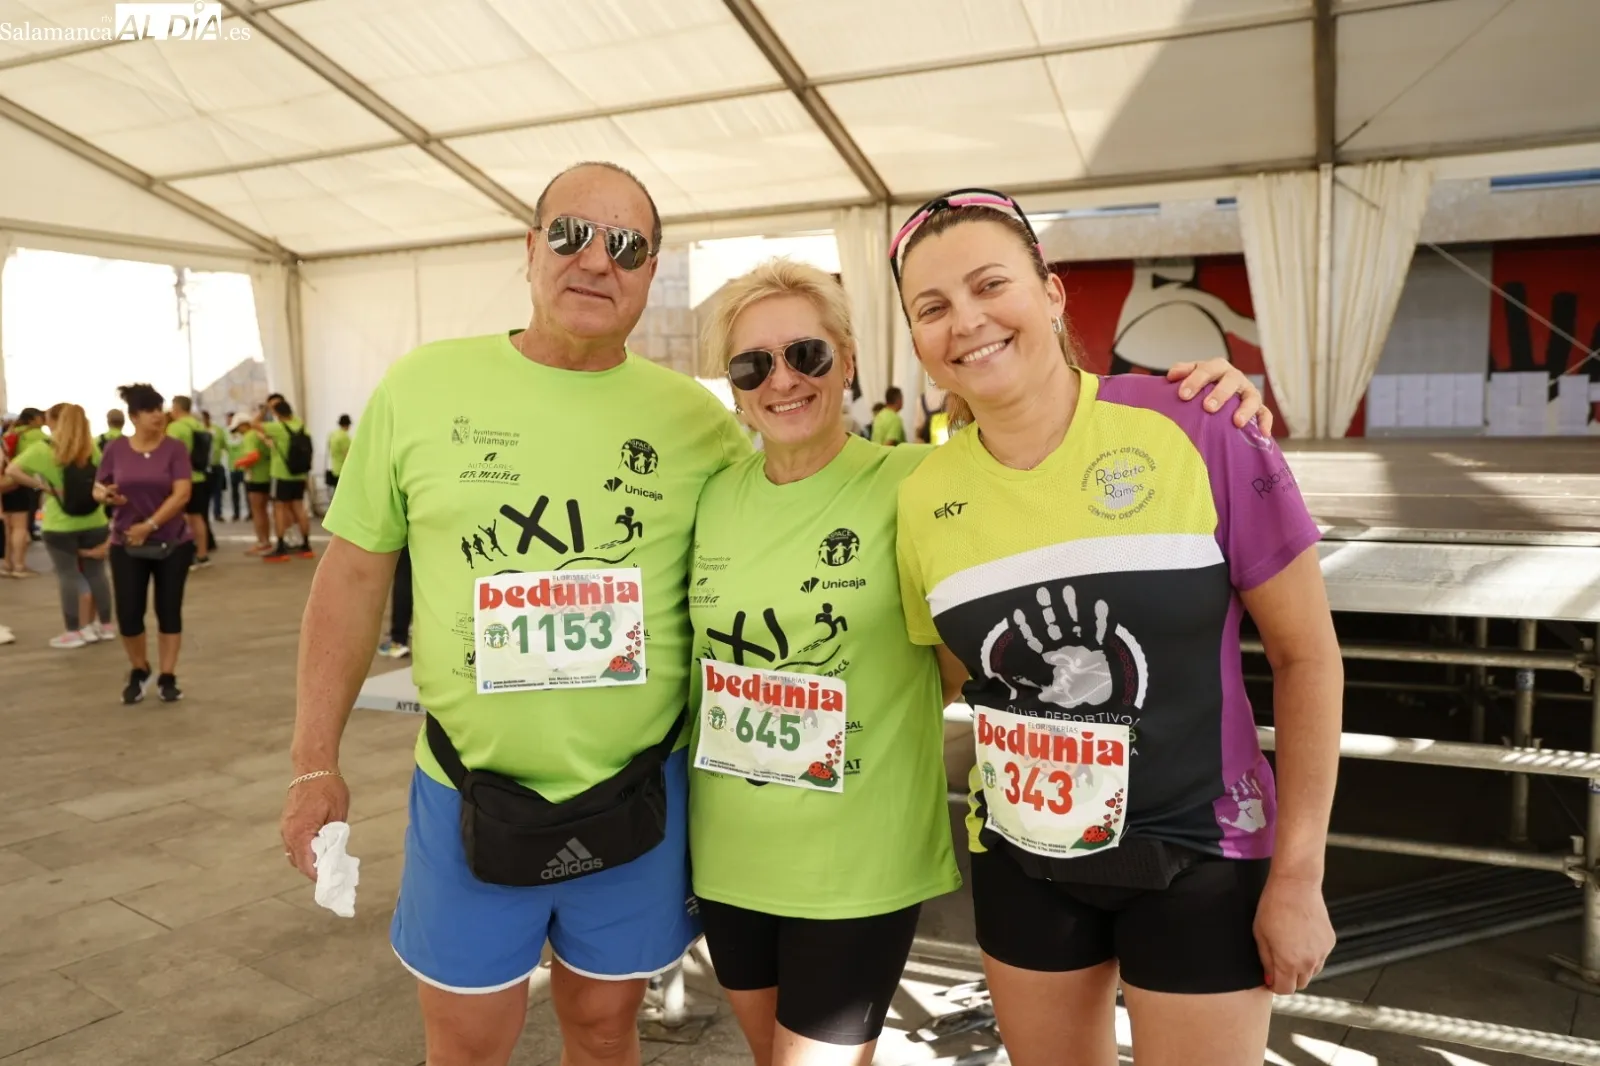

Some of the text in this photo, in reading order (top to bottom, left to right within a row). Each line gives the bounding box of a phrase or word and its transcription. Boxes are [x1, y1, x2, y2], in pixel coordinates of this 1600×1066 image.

[473, 436, 519, 447] Villamayor
[1095, 465, 1146, 486] Roberto
[625, 484, 663, 501] Unicaja
[1104, 483, 1145, 499] Ramos
[933, 500, 969, 520] EKT
[1087, 488, 1156, 521] CENTRO DEPORTIVO
[499, 495, 586, 555] XI
[479, 576, 639, 611] bedunia
[822, 576, 866, 590] Unicaja
[511, 611, 613, 654] 1153
[705, 665, 843, 713] bedunia
[735, 706, 801, 752] 645
[1027, 721, 1079, 734] FLORISTERÍAS
[1045, 711, 1132, 725] DEPORTIVO
[977, 713, 1124, 767] bedunia
[1003, 761, 1073, 815] 343
[540, 858, 604, 880] adidas
